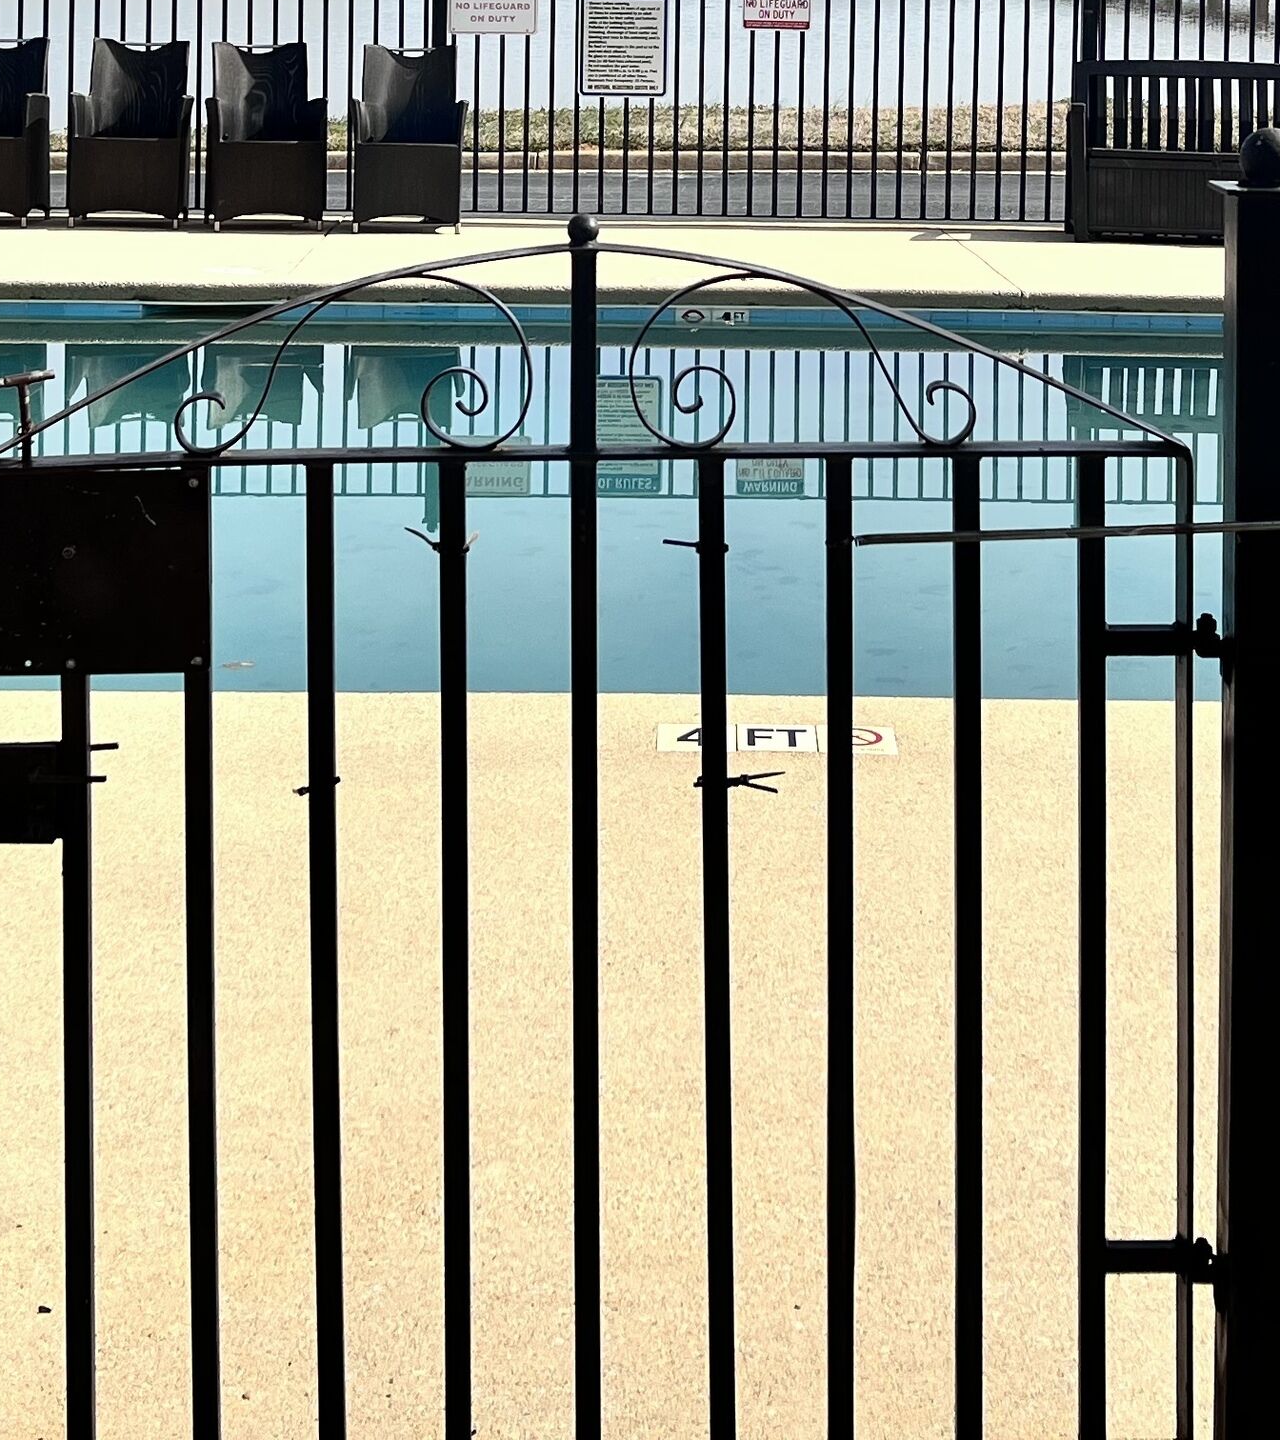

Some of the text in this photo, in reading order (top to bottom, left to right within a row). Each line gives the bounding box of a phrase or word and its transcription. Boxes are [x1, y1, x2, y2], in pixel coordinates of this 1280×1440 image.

[455, 2, 531, 11] NO LIFEGUARD
[759, 0, 809, 9] LIFEGUARD
[758, 9, 795, 19] ON DUTY
[470, 15, 516, 23] ON DUTY
[746, 728, 808, 748] FT
